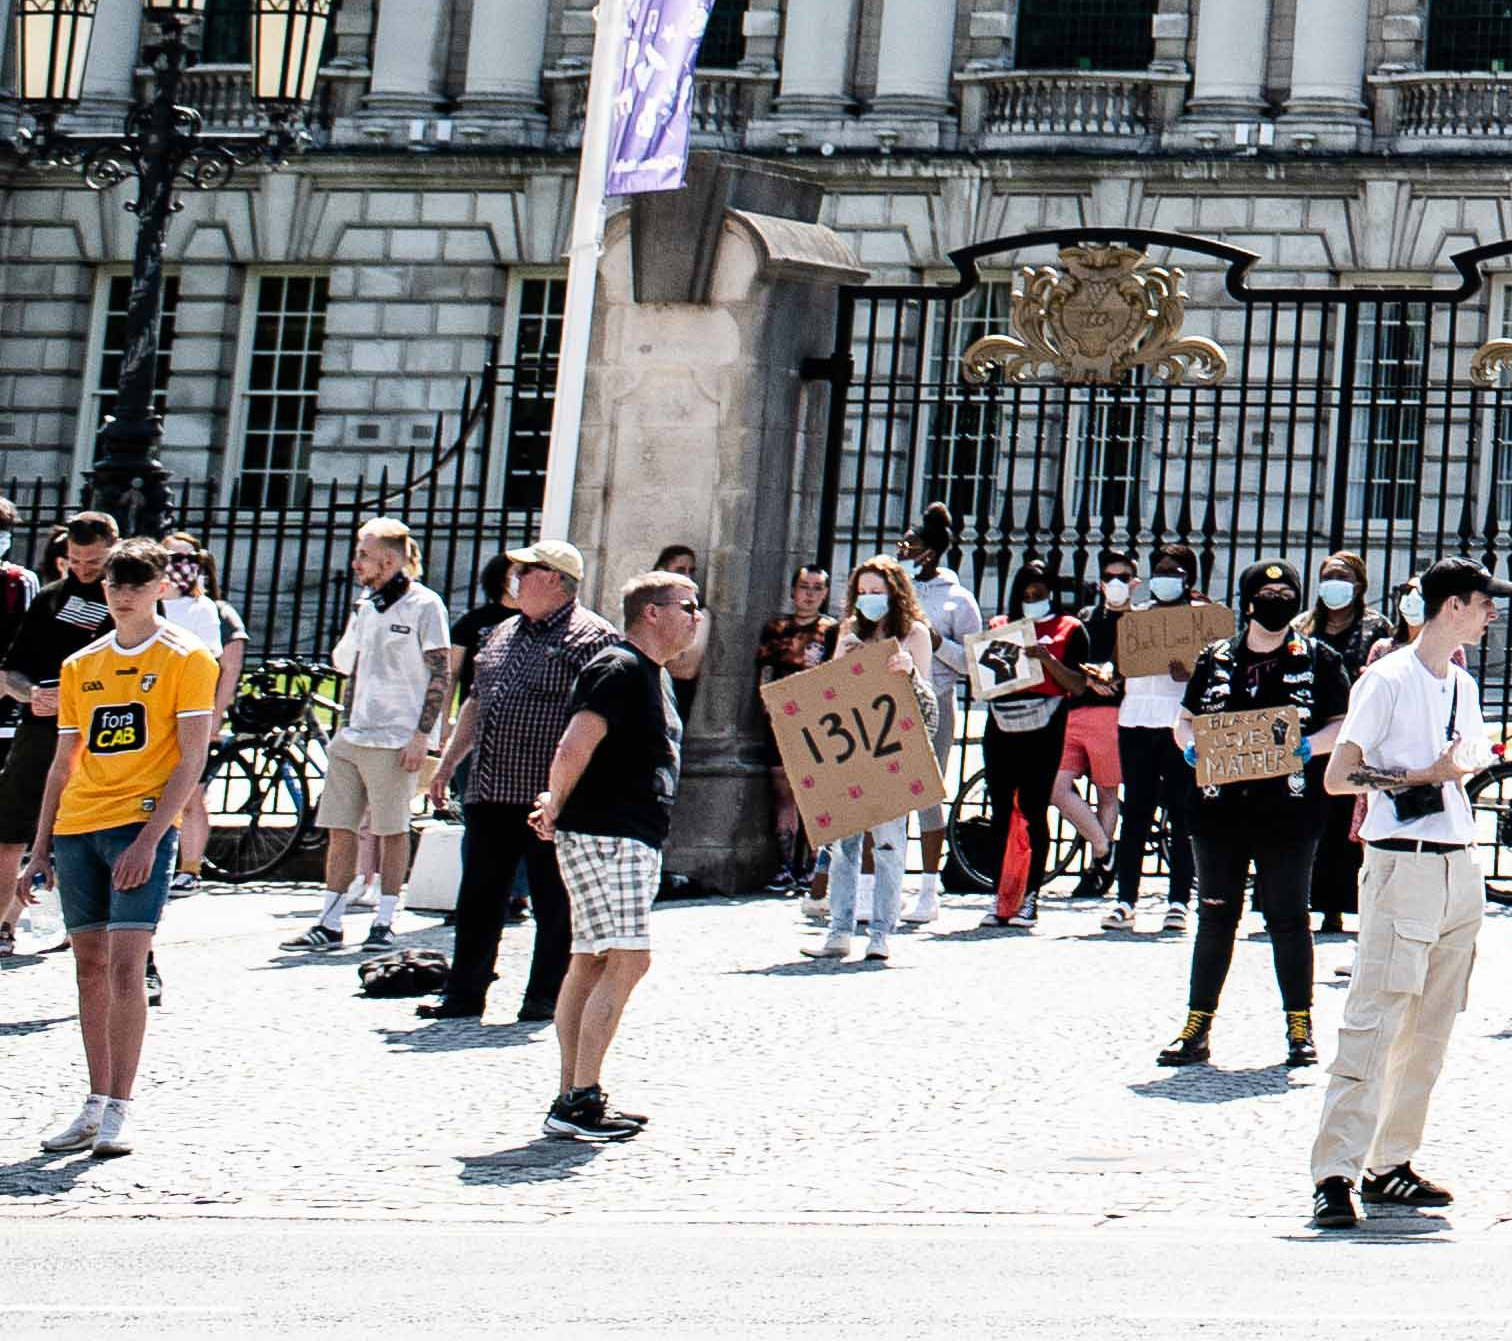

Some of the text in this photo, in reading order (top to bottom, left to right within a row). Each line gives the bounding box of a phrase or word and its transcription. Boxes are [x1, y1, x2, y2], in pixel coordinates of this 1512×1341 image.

[801, 693, 903, 765] 1312
[1208, 711, 1270, 730] BLACK
[96, 727, 136, 748] CAB
[1213, 728, 1270, 750] LIVES
[1205, 748, 1291, 781] MATTER
